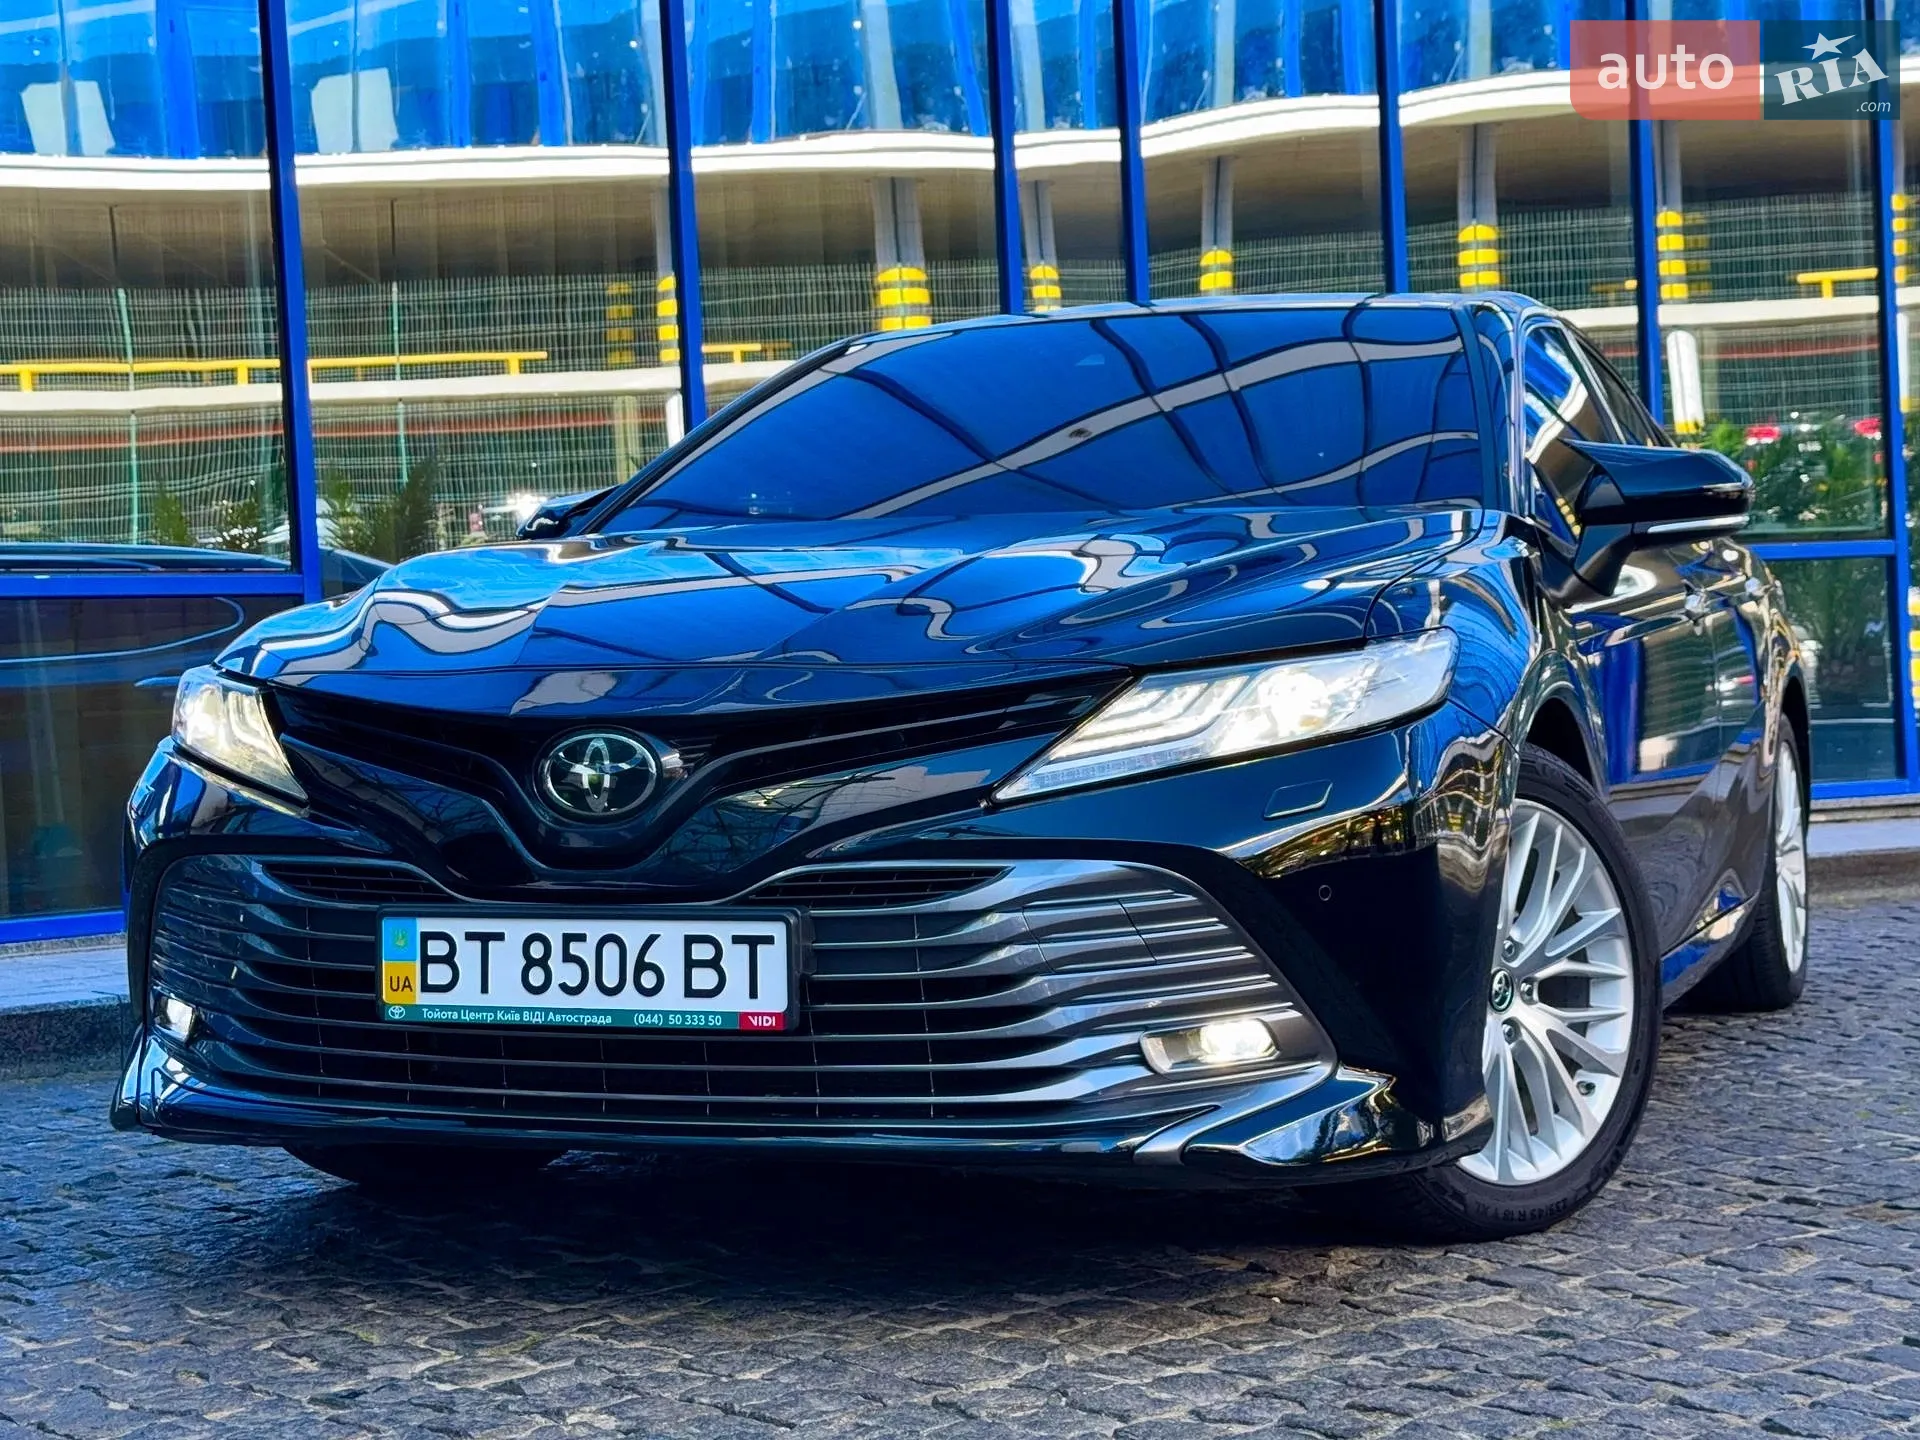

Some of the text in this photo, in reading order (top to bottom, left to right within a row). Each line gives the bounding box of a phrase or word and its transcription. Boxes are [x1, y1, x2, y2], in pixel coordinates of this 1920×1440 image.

[420, 931, 775, 999] BT 8506 BT
[389, 975, 413, 992] UA
[422, 1008, 612, 1026] Тойота Центр Київ ВІДІ Автострада
[633, 1013, 722, 1026] (044) 50 333 50
